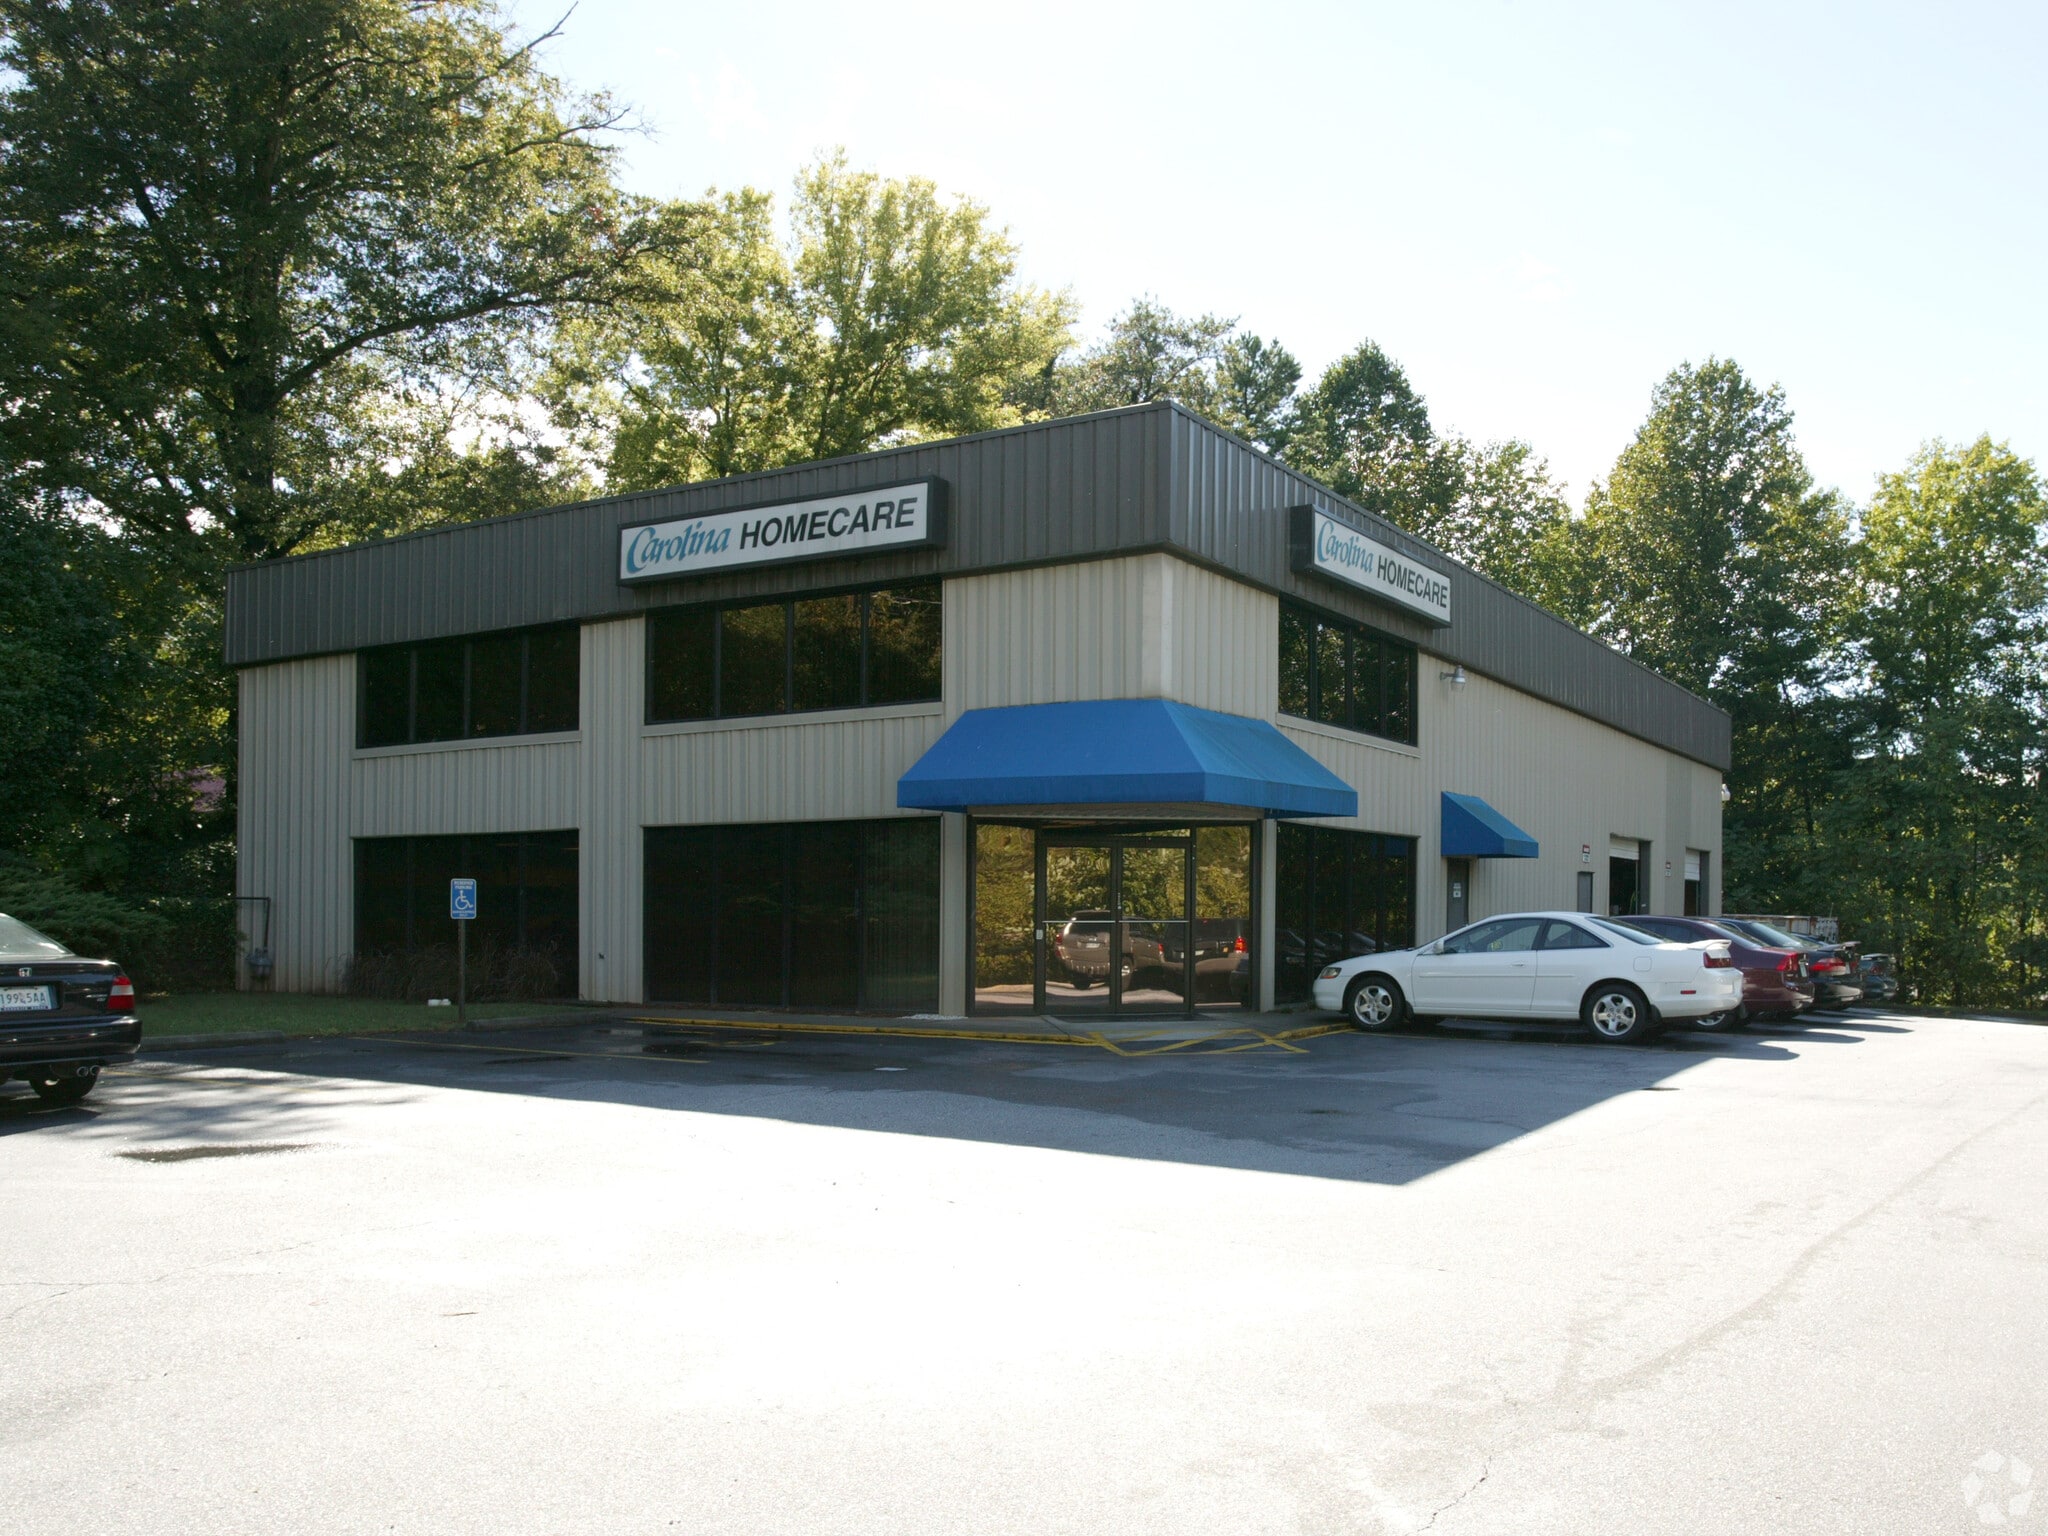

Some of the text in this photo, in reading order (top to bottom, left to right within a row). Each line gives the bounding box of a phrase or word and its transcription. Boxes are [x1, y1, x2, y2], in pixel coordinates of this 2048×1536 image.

[626, 498, 918, 574] Carolina HOMECARE
[1317, 520, 1448, 609] Carolina HOMECARE
